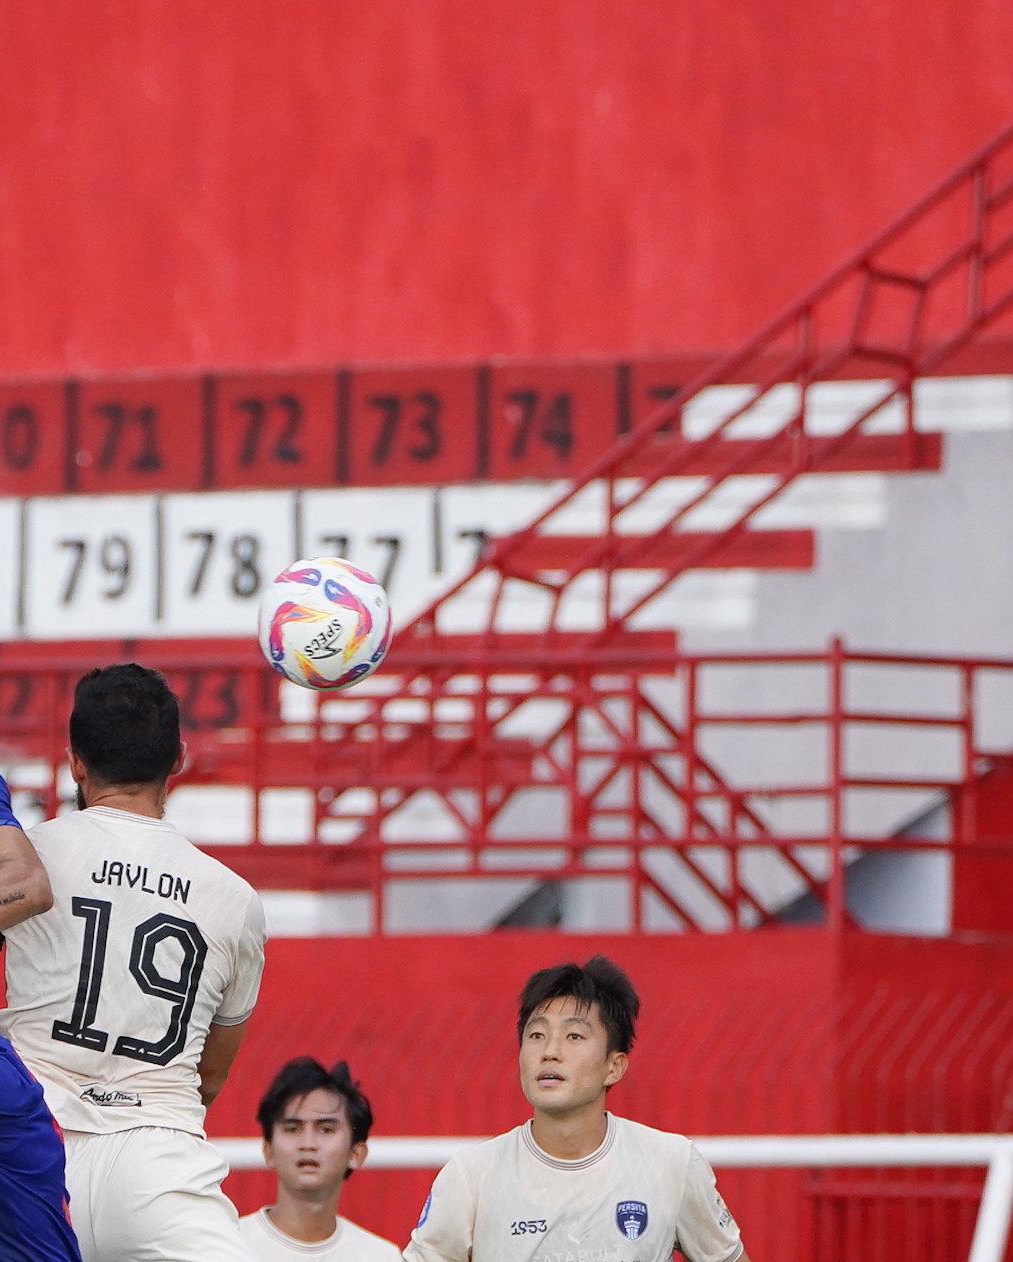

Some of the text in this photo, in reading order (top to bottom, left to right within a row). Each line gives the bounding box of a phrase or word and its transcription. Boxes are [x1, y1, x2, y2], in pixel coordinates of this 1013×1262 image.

[94, 402, 162, 472] 71
[235, 395, 305, 467] 72
[368, 392, 443, 462] 73
[504, 390, 574, 461] 74
[57, 535, 131, 608] 79
[185, 531, 261, 603] 78
[304, 619, 342, 657] SPECS
[51, 895, 209, 1067] 19
[510, 1219, 548, 1236] 1953
